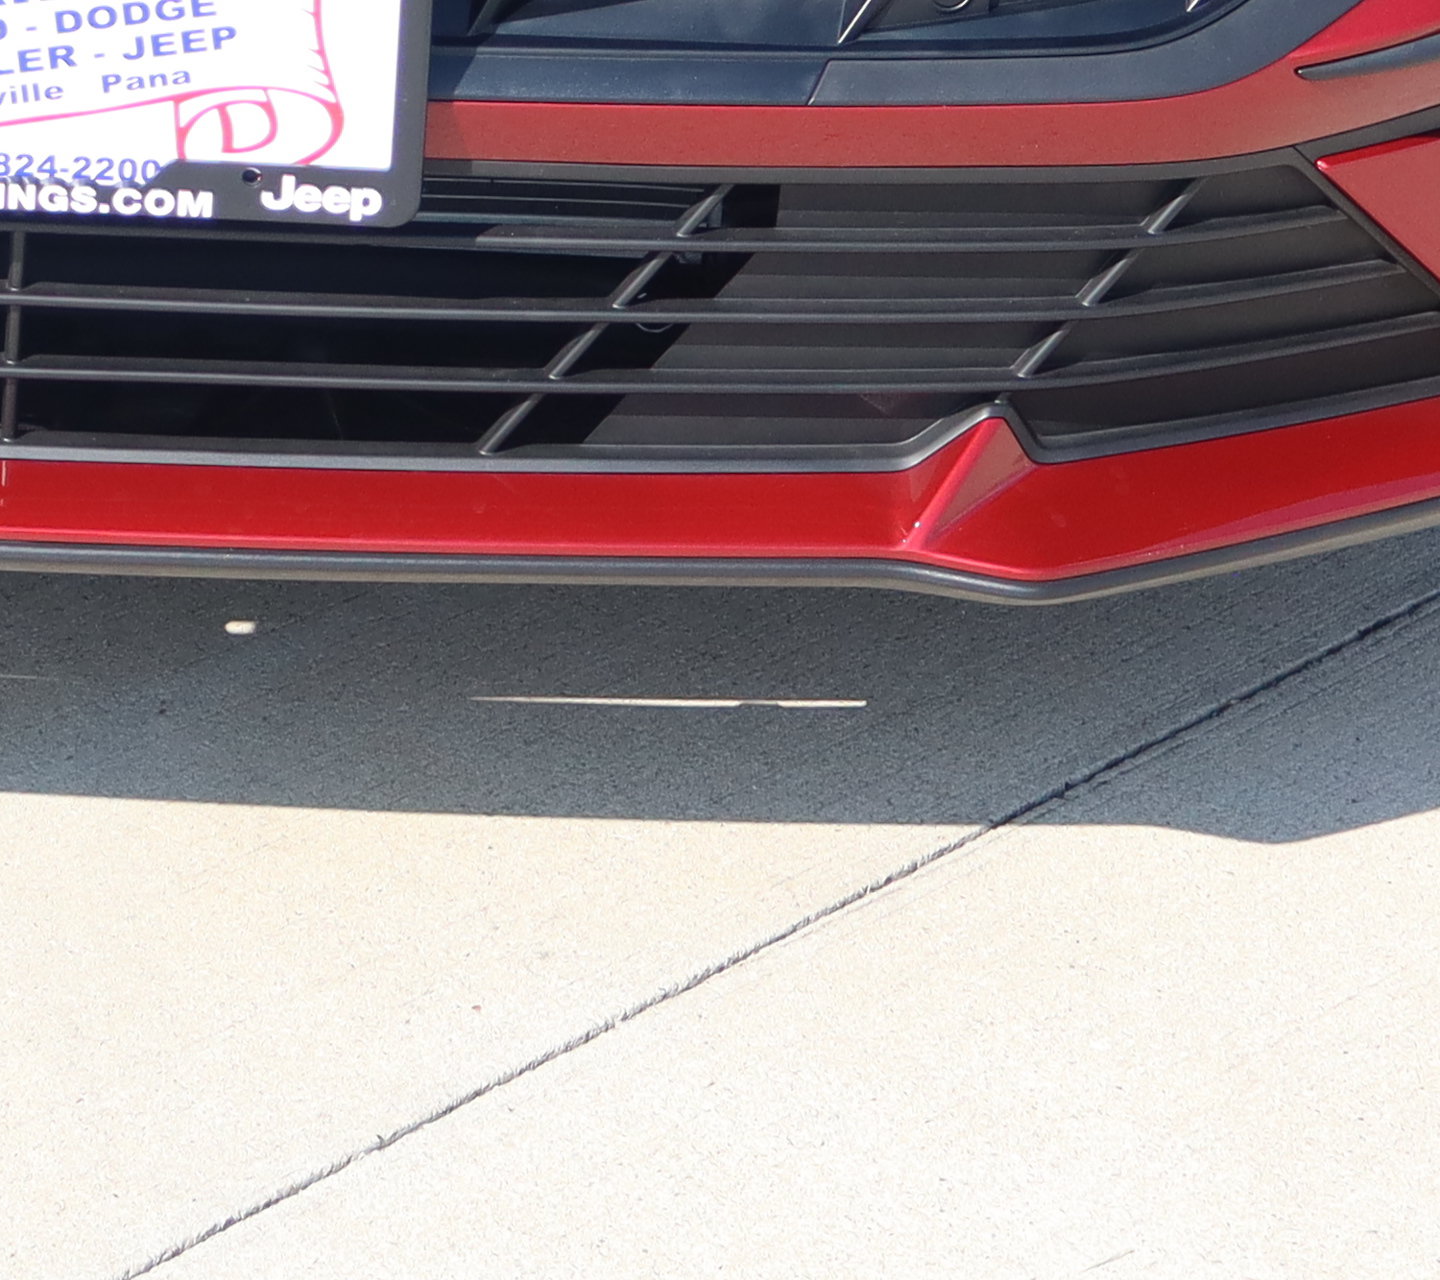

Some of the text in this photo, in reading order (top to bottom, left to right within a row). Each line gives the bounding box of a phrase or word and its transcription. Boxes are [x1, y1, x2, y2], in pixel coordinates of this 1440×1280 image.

[122, 26, 238, 61] JEEP
[101, 68, 192, 94] Pana
[260, 173, 383, 222] Jeep
